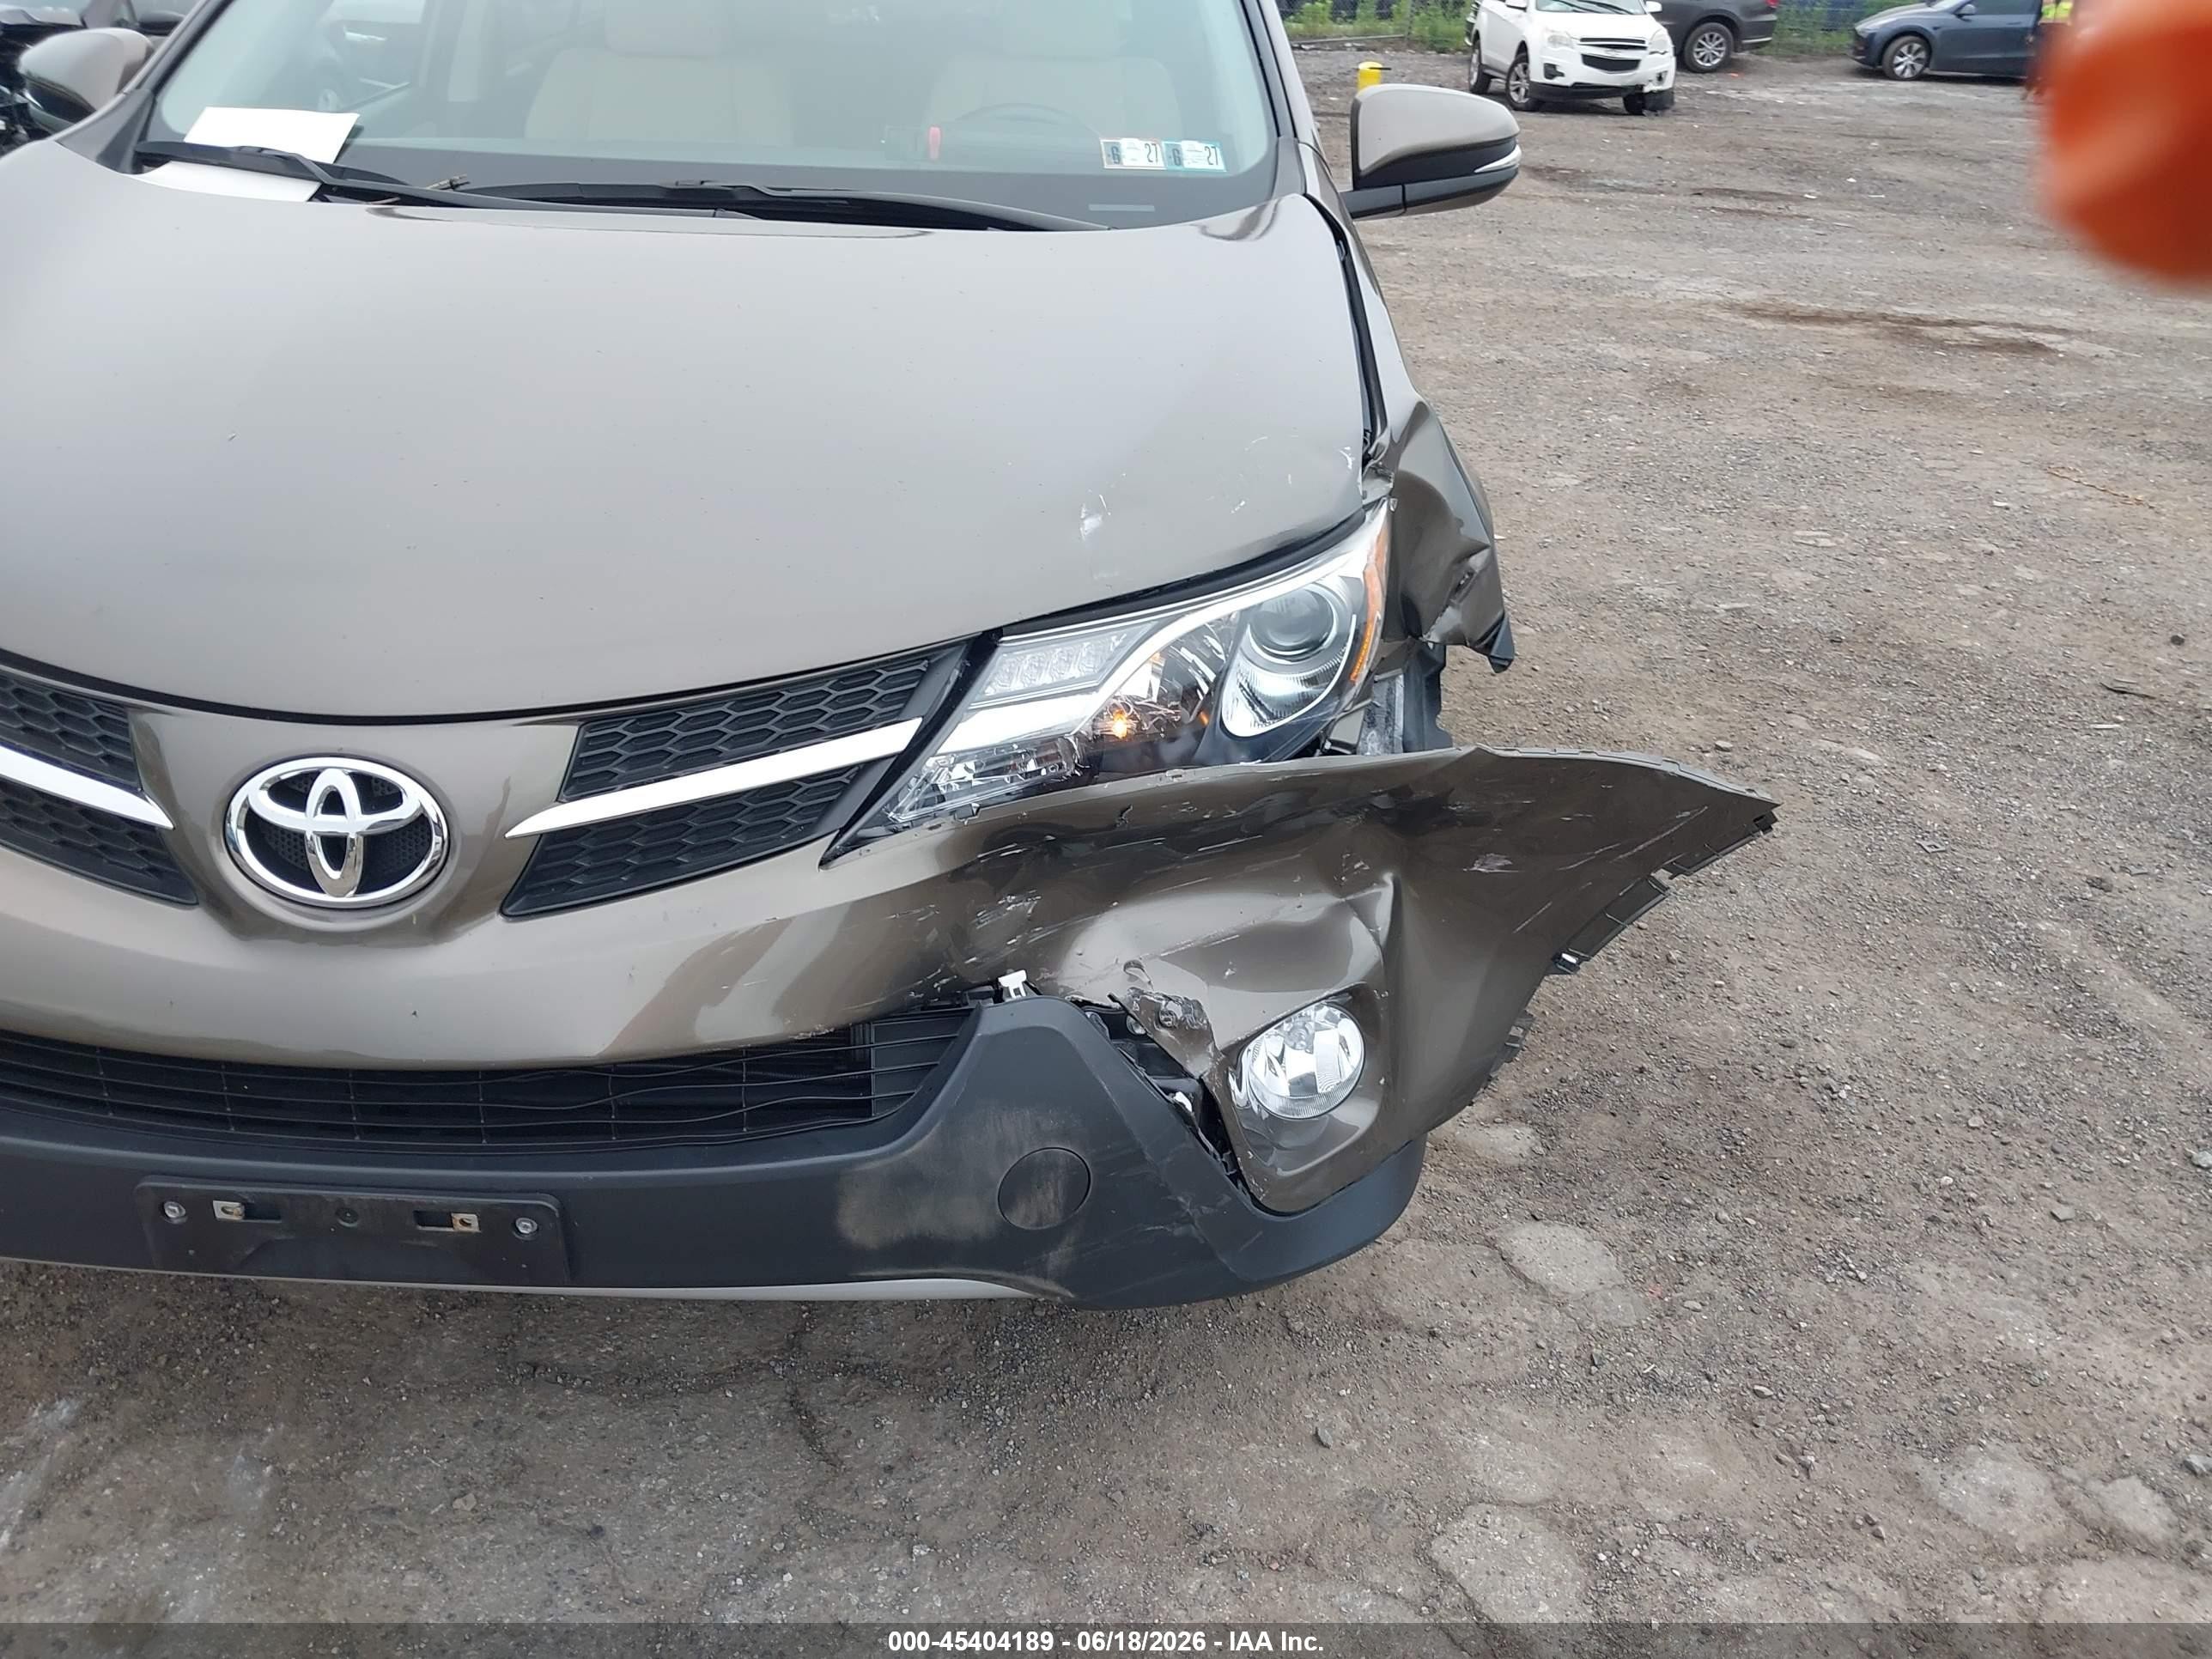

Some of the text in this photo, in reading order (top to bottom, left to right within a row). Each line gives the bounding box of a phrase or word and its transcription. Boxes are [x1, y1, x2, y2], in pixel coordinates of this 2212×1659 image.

[1145, 143, 1158, 163] 27
[1172, 148, 1182, 166] 6
[1204, 145, 1218, 166] 27
